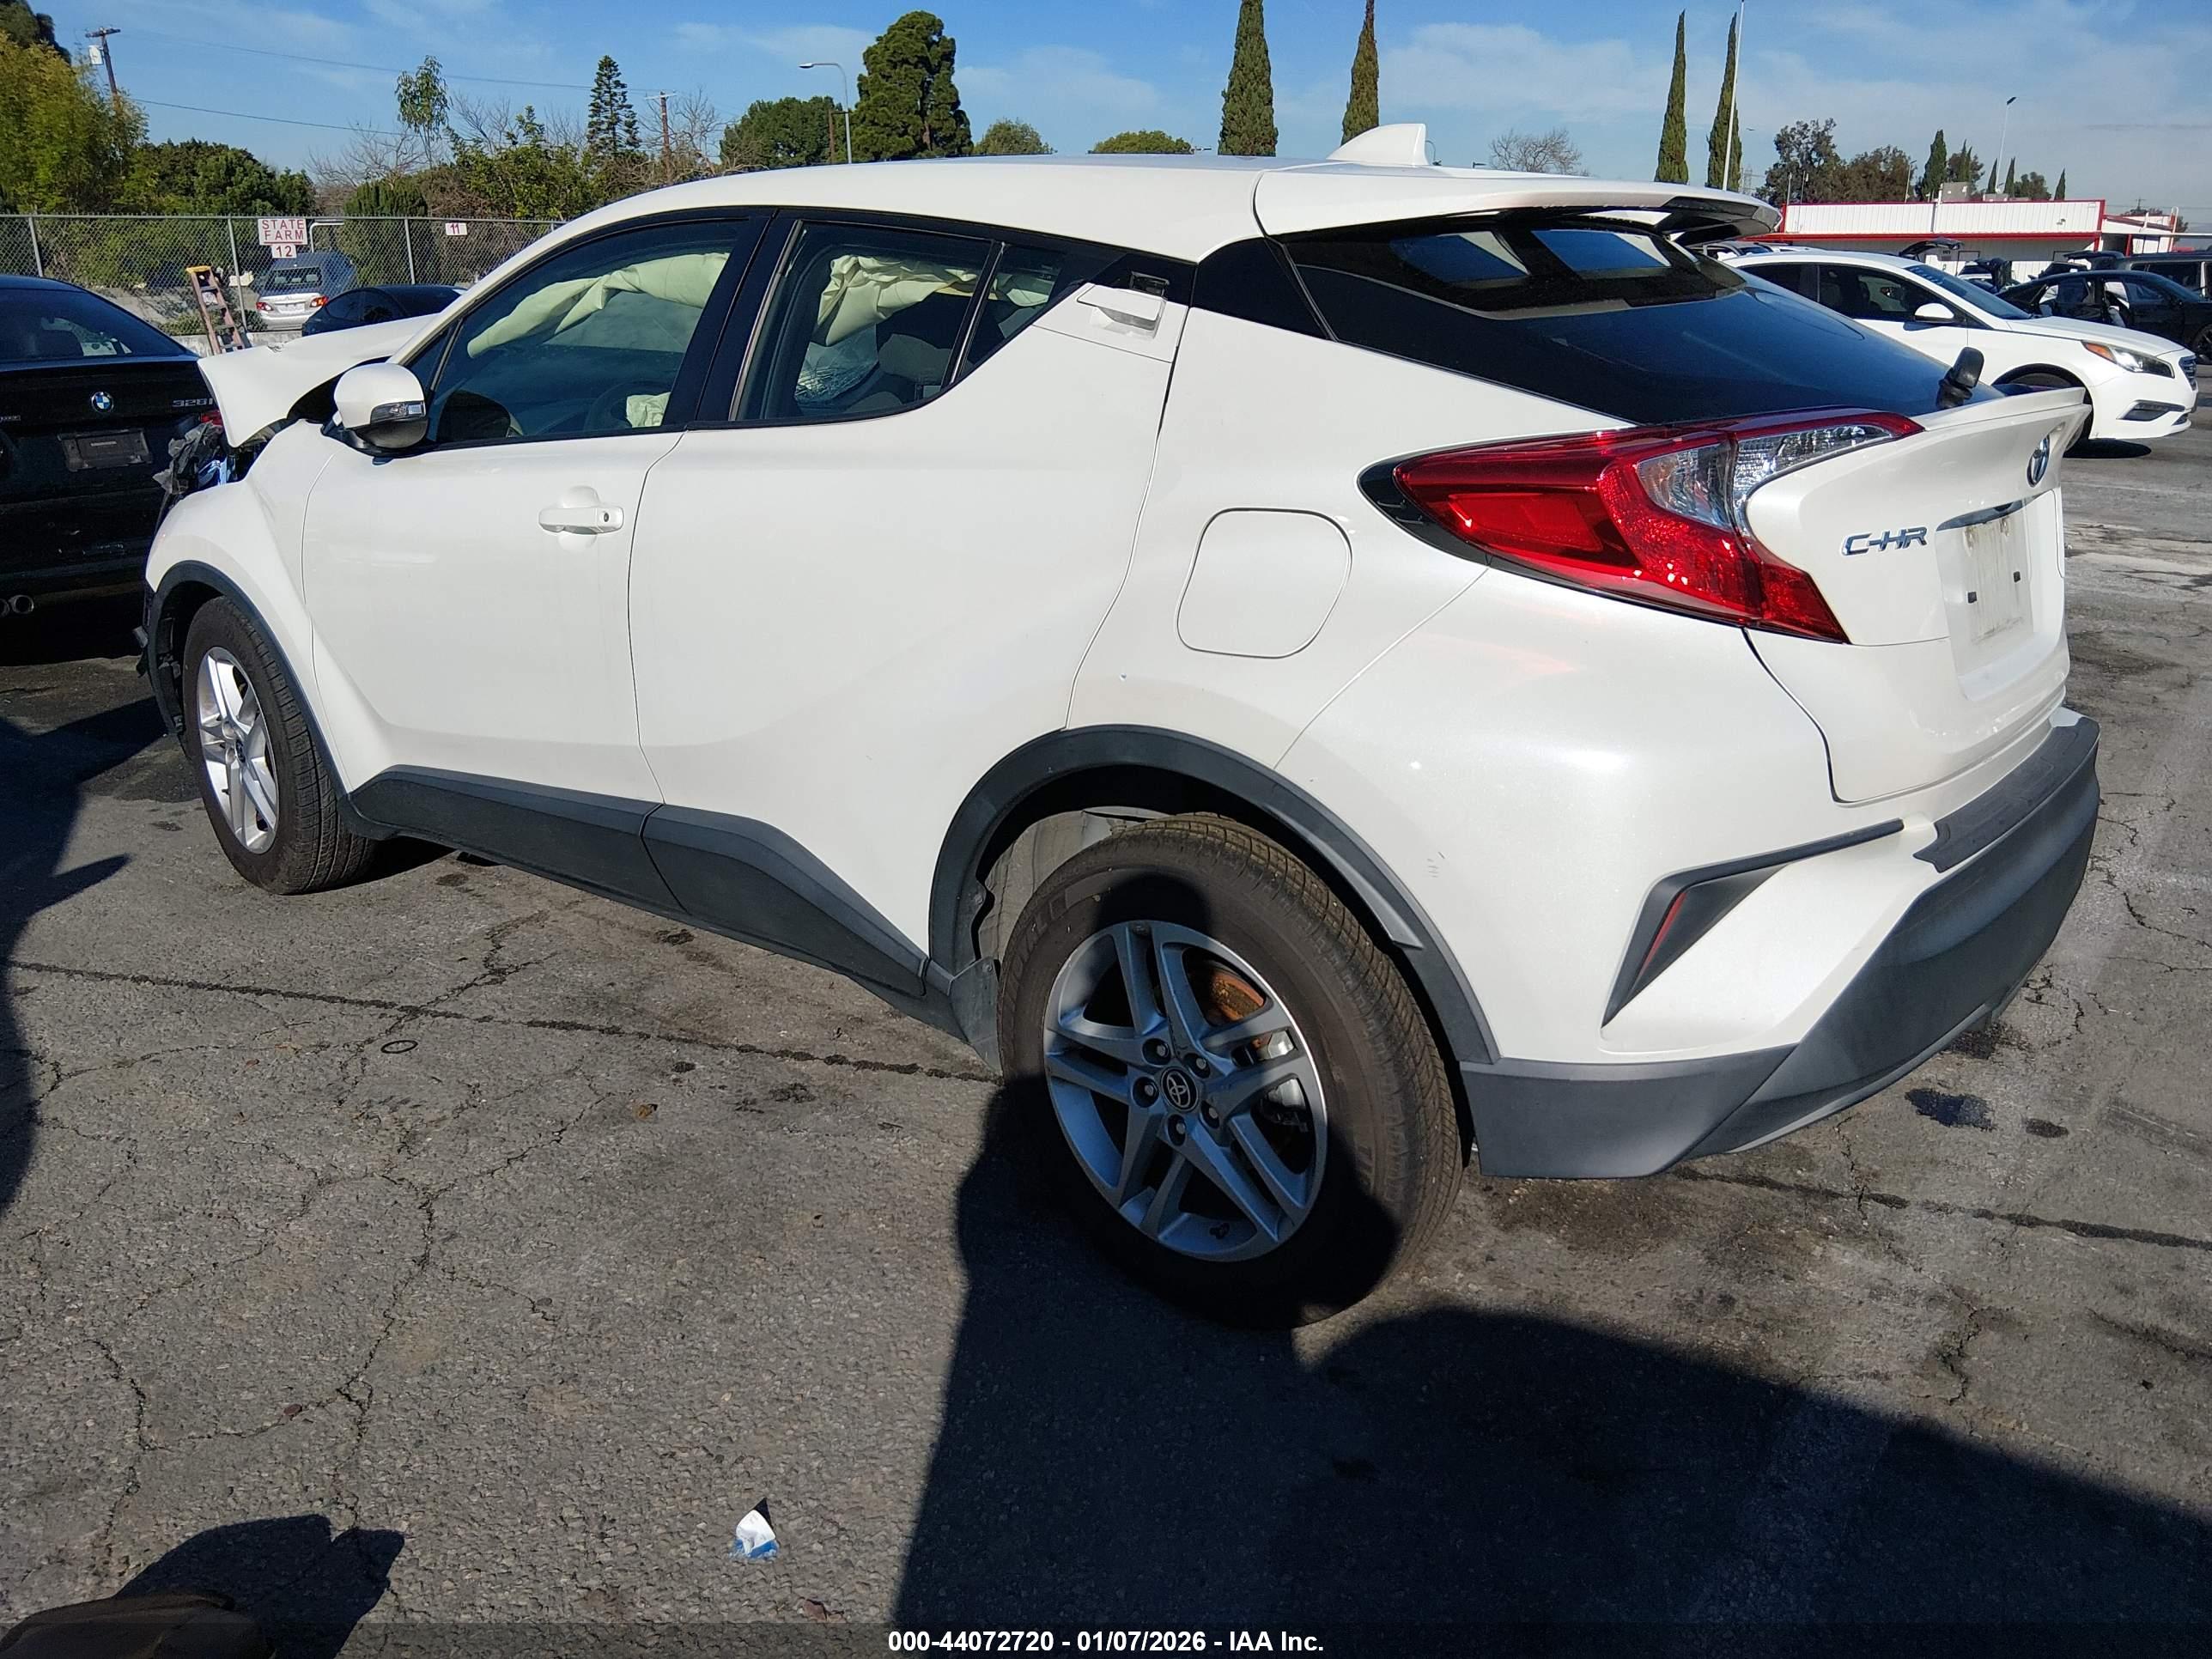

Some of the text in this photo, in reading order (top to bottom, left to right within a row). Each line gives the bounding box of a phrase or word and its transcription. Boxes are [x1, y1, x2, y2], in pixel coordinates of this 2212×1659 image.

[262, 220, 304, 229] STATE
[450, 223, 459, 234] 11
[264, 230, 303, 240] FARM
[276, 246, 293, 257] 12
[1842, 526, 1928, 556] C-HR
